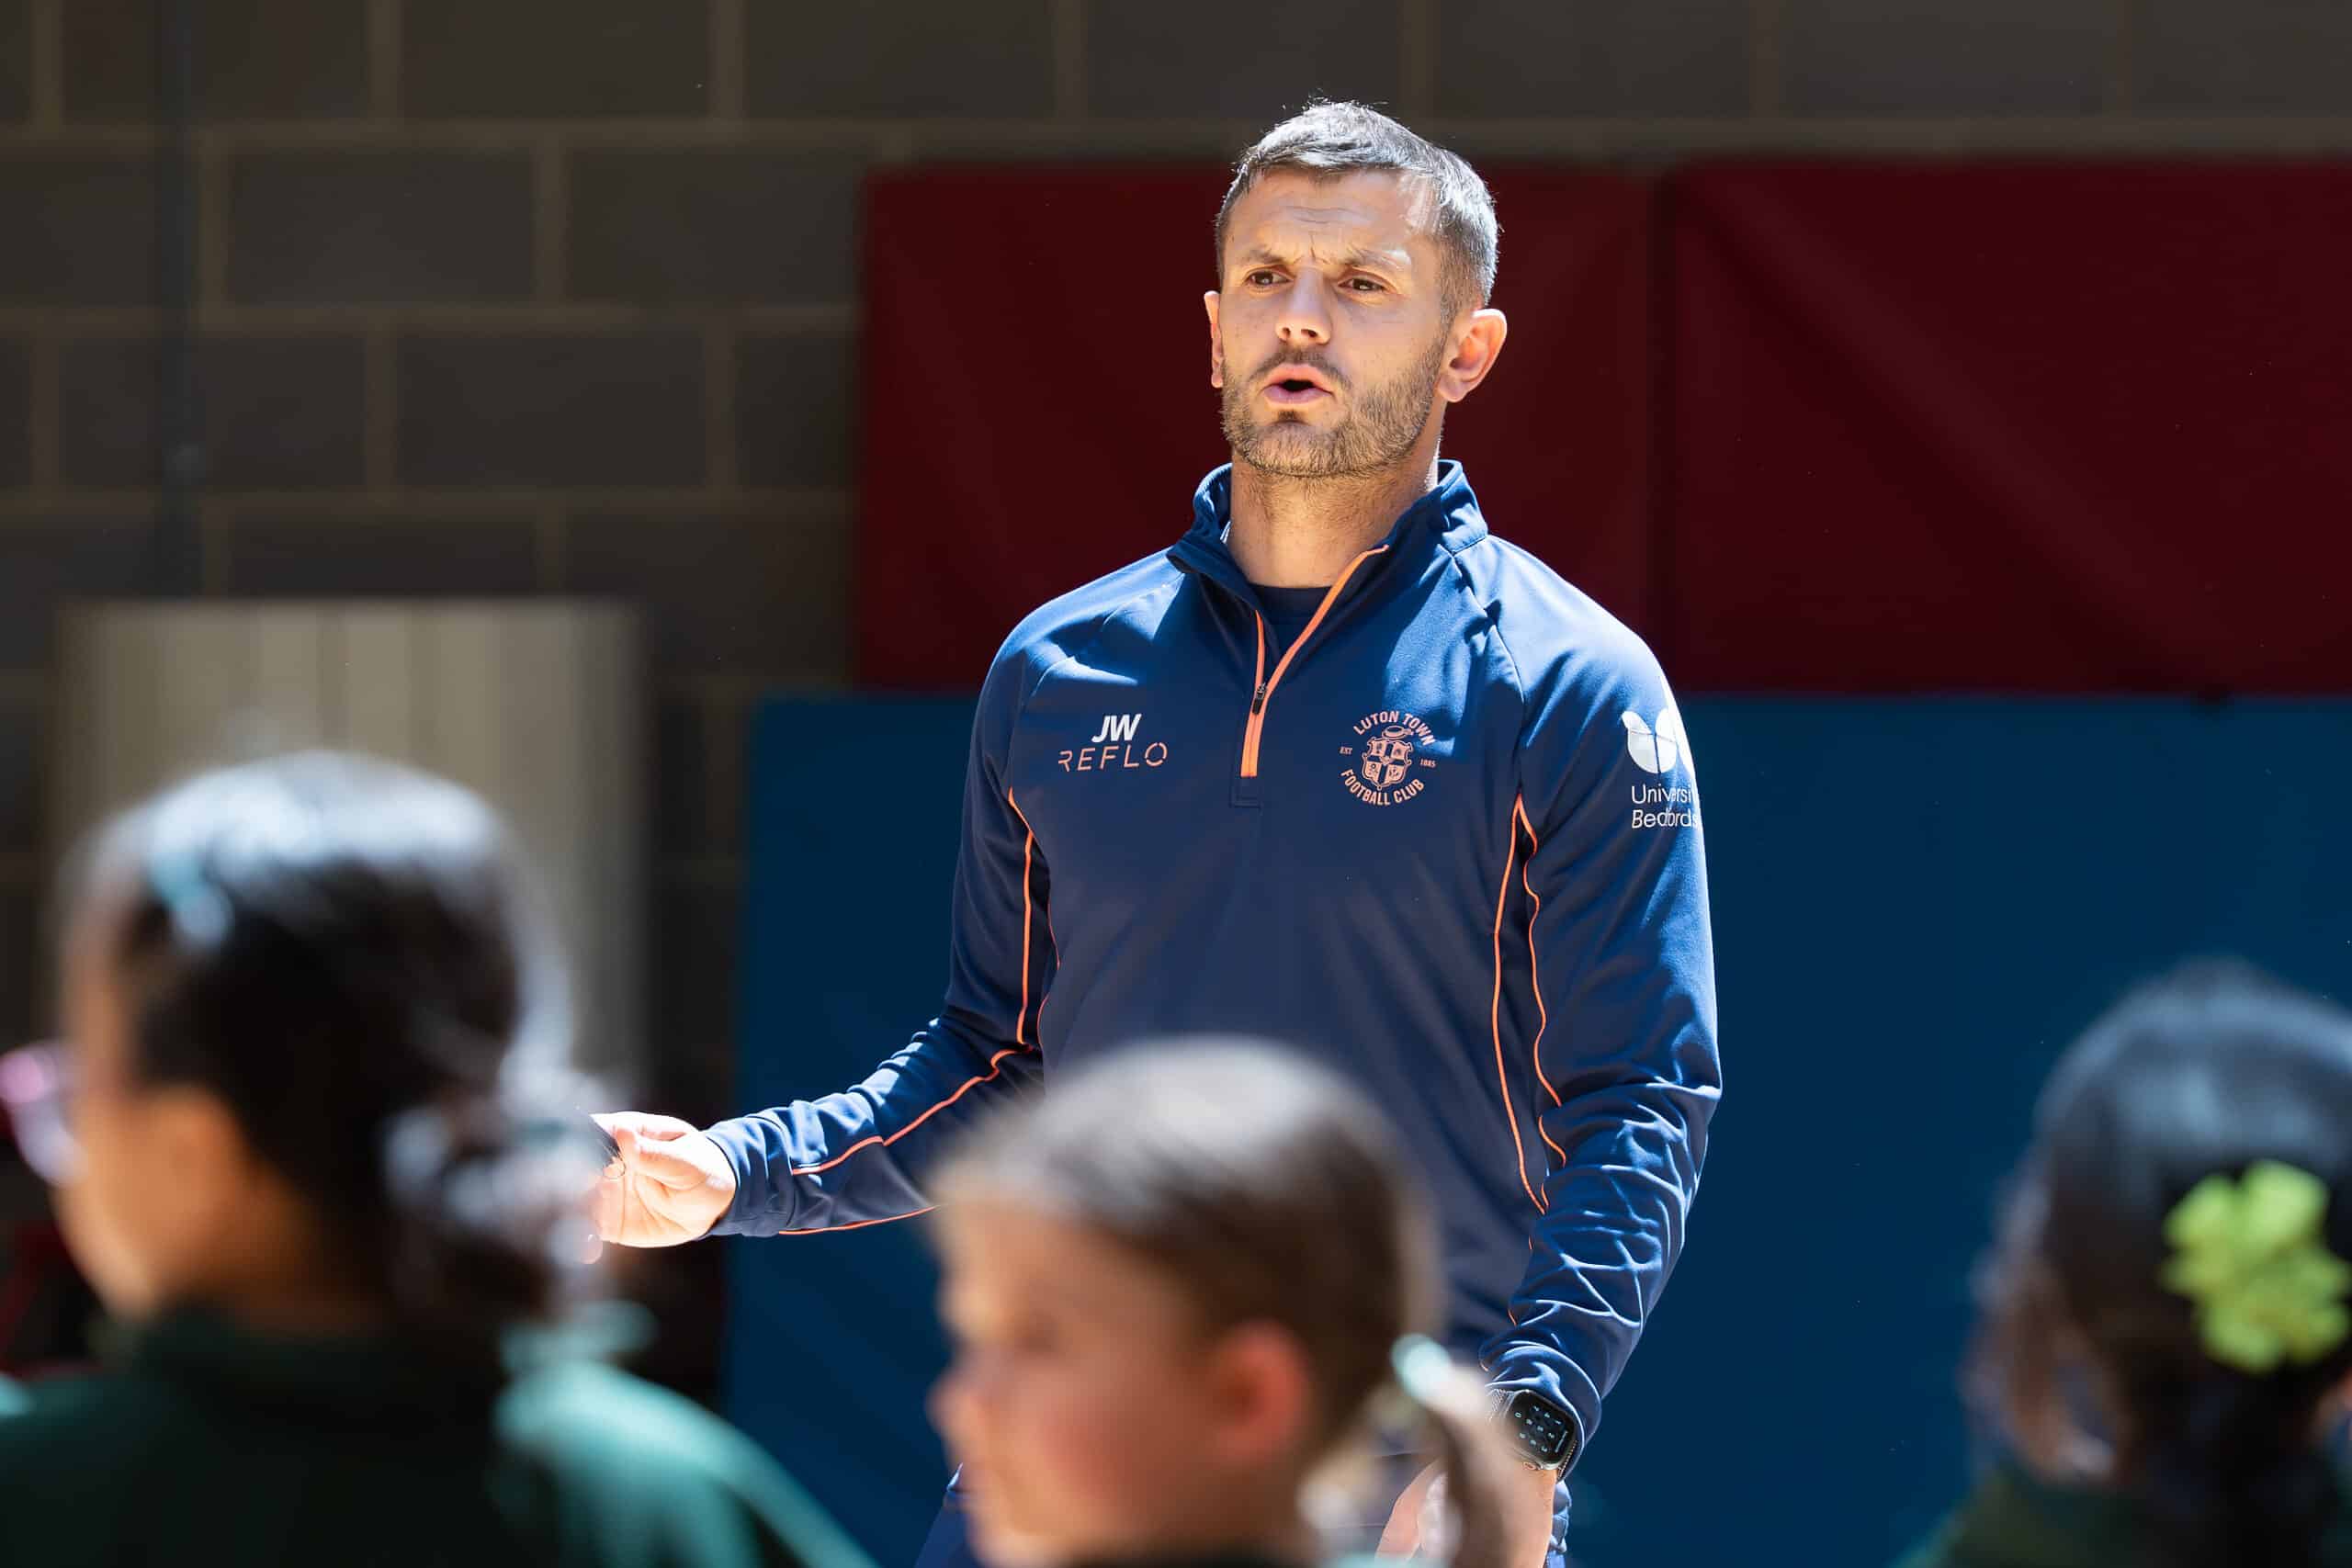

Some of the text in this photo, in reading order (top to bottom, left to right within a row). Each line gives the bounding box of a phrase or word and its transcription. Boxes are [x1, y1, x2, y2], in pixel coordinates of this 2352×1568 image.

[1091, 714, 1142, 743] JW
[1353, 711, 1436, 746] LUTON TOWN
[1057, 742, 1169, 773] REFLO
[1340, 769, 1425, 806] FOOTBALL CLUB
